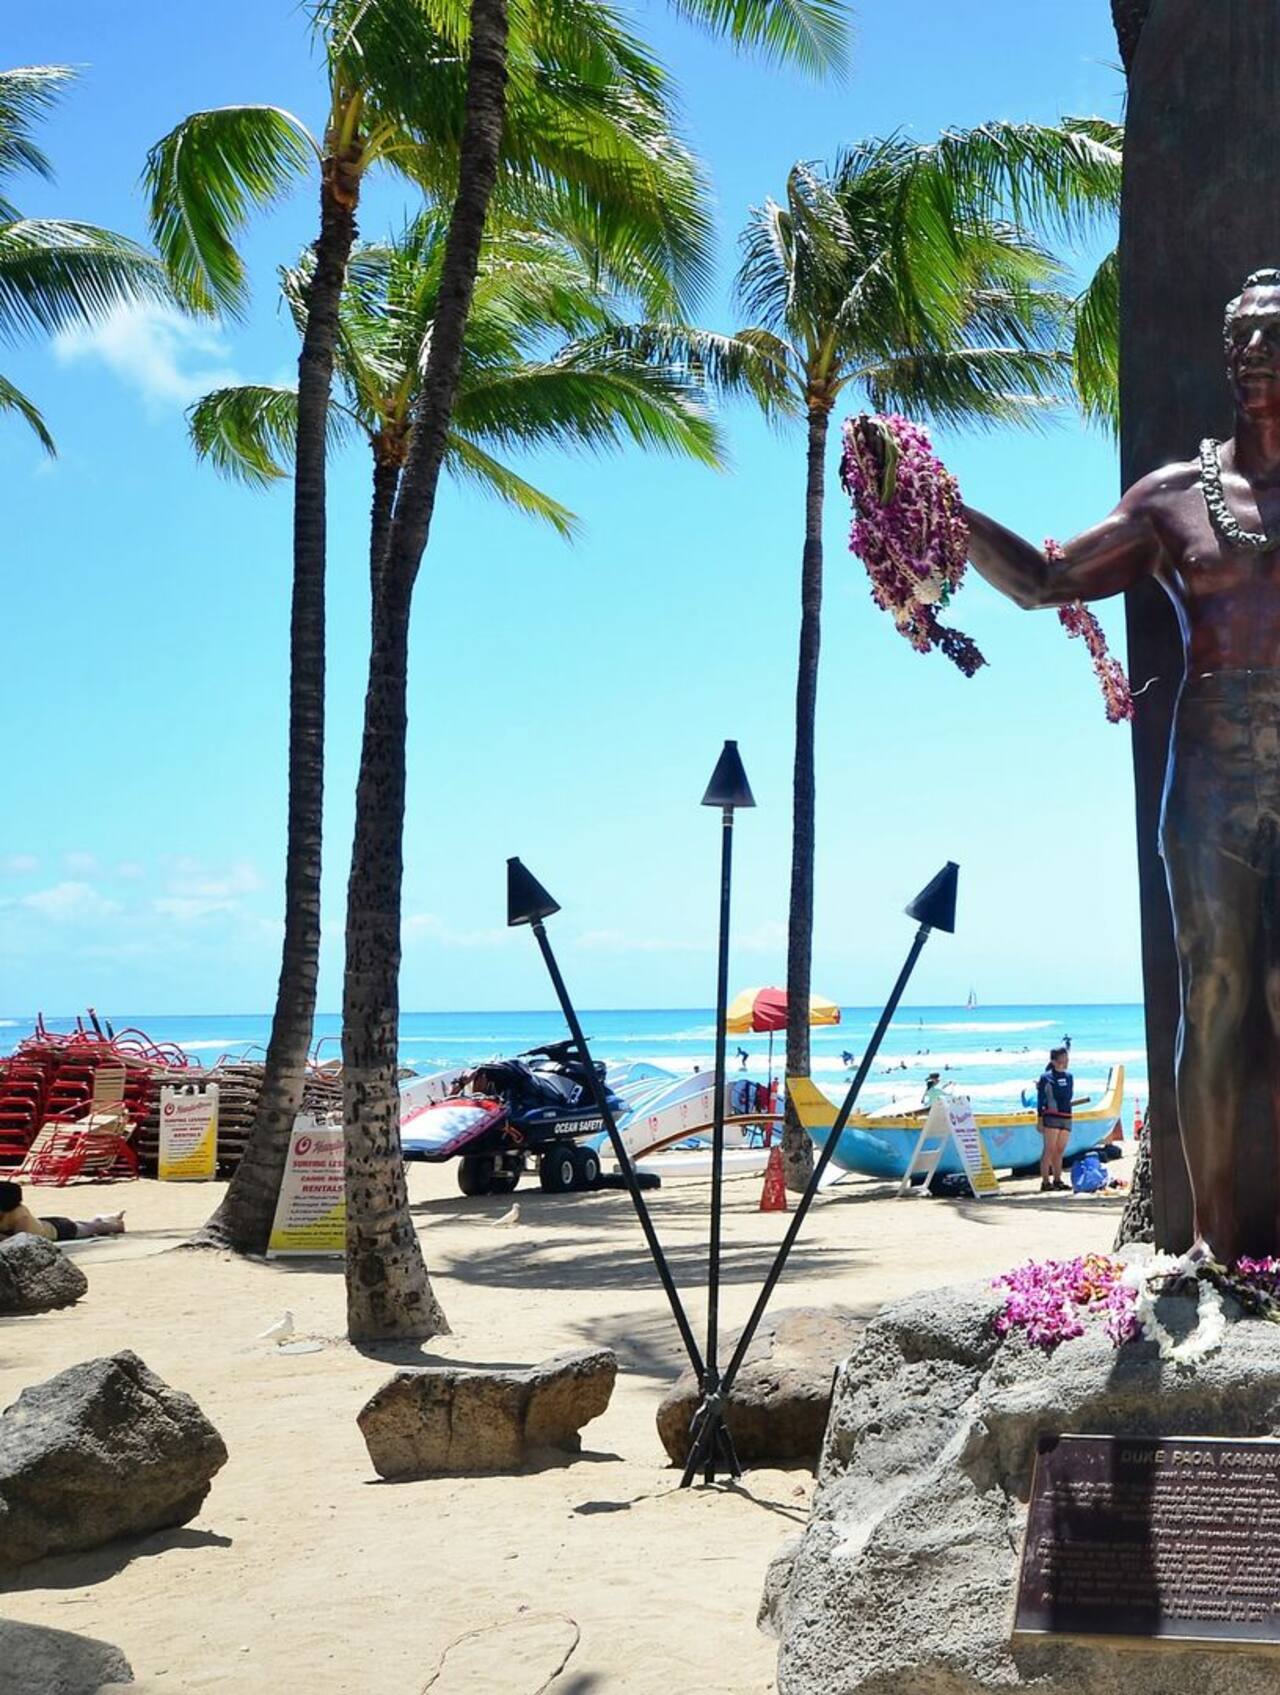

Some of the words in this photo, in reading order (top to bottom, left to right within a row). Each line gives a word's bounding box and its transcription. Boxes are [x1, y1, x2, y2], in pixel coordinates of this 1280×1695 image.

[554, 1121, 578, 1134] OCEAN
[579, 1119, 604, 1132] SAFETY
[292, 1159, 327, 1168] SURFING
[302, 1184, 343, 1193] RENTALS
[1120, 1448, 1166, 1464] DUKE
[1172, 1450, 1216, 1467] PAOA
